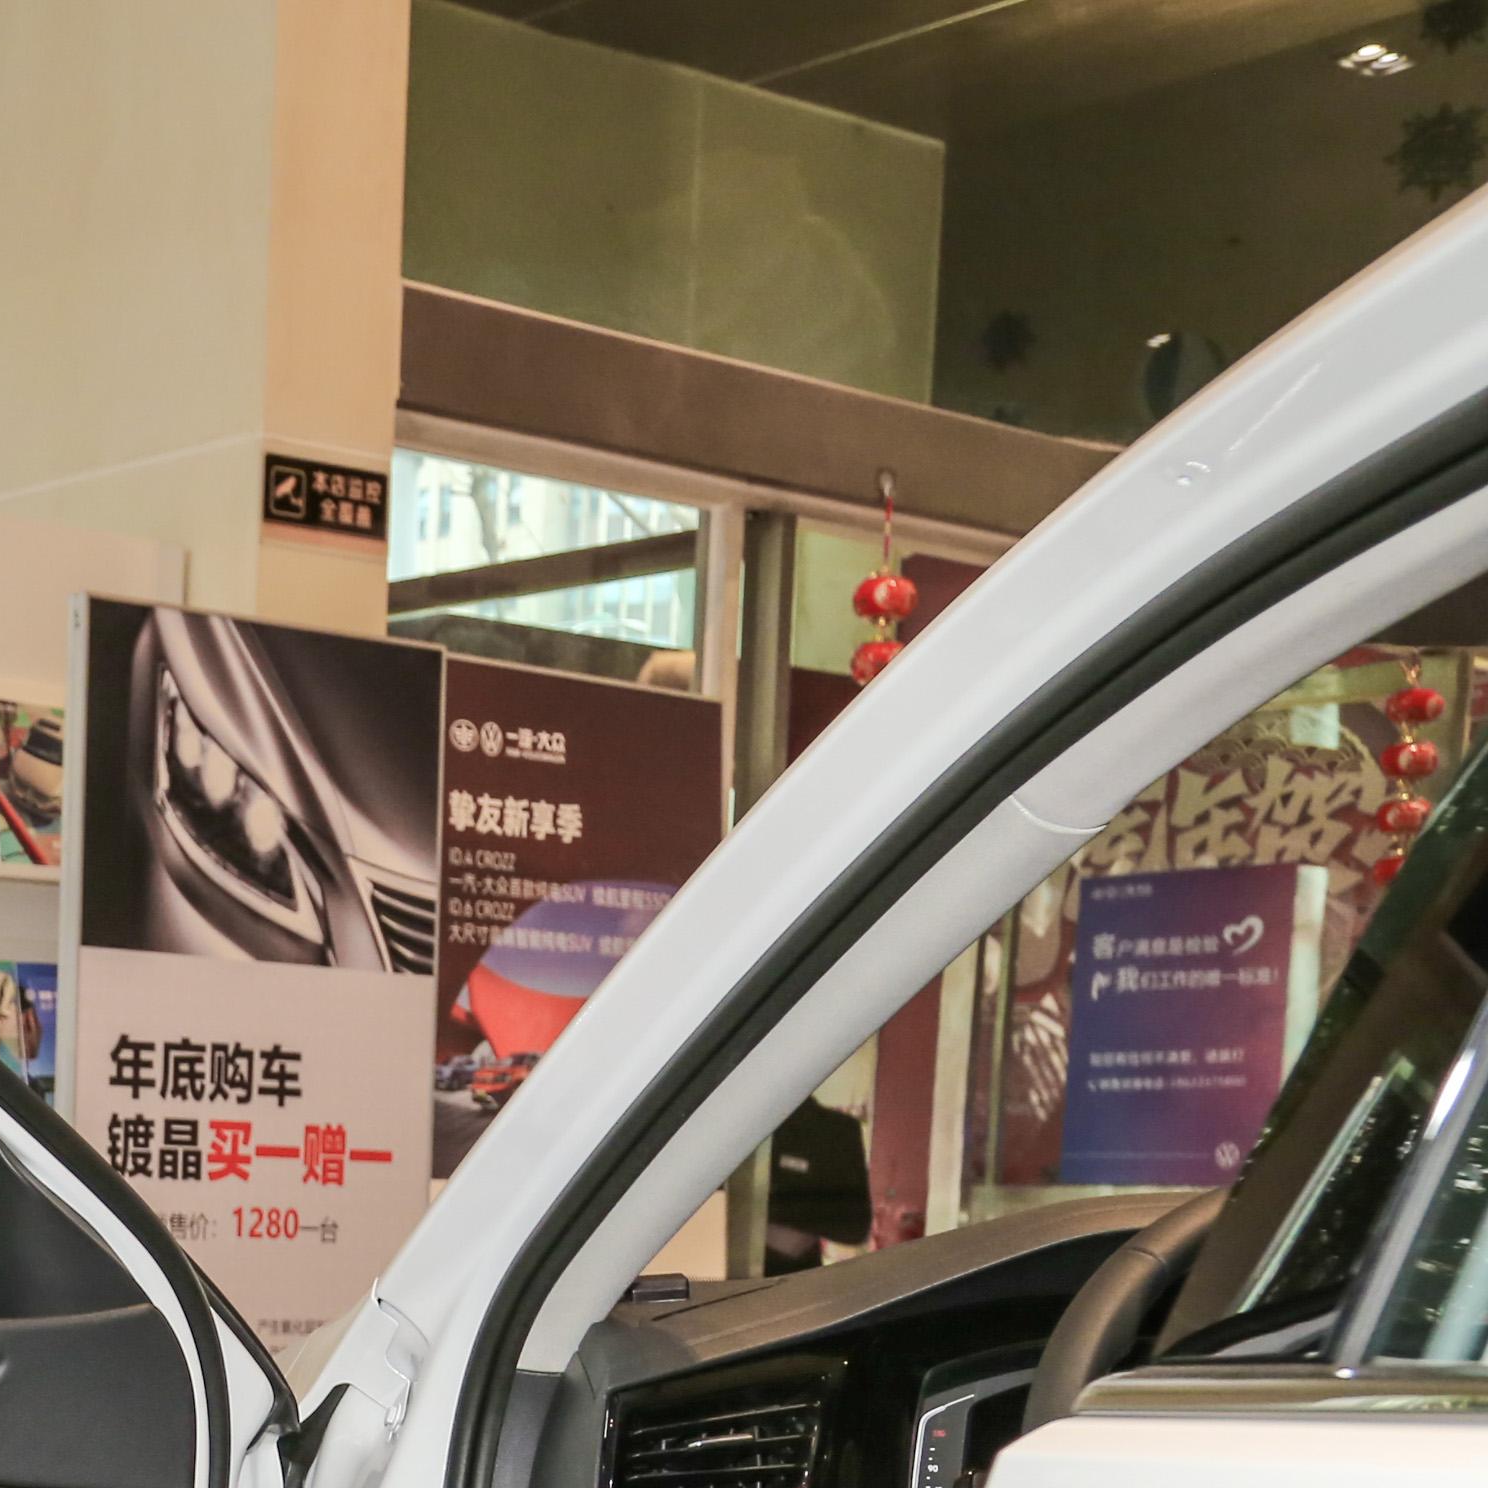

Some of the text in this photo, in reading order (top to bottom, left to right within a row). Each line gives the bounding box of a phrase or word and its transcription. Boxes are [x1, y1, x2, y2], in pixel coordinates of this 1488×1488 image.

[448, 789, 583, 844] 挚友新享季
[109, 1034, 302, 1107] 年底购车
[107, 1113, 393, 1187] 镀晶买一赠一
